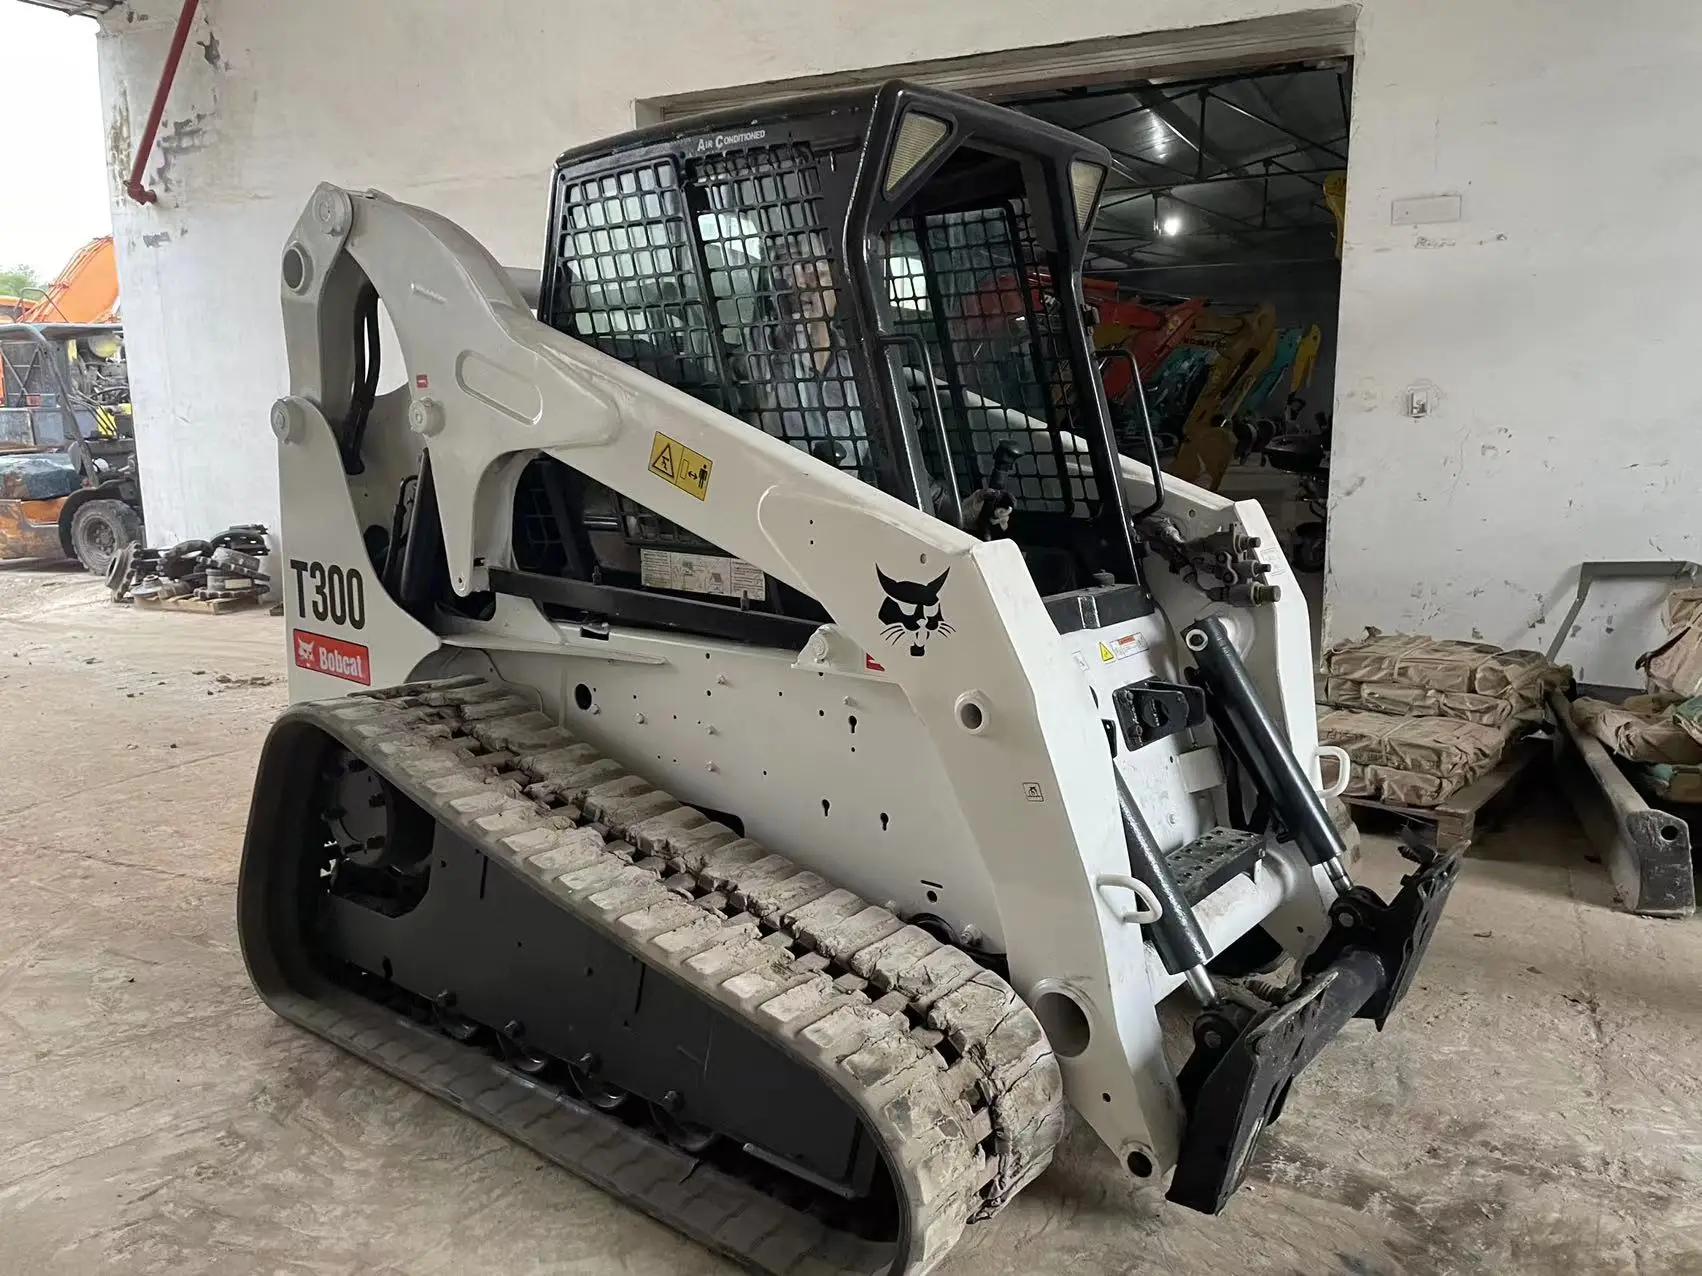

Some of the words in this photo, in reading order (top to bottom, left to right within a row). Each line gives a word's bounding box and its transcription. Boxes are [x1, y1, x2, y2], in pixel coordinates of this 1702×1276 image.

[715, 129, 766, 149] CONDITIONED
[290, 559, 366, 630] T300
[319, 647, 363, 678] Bobcat
